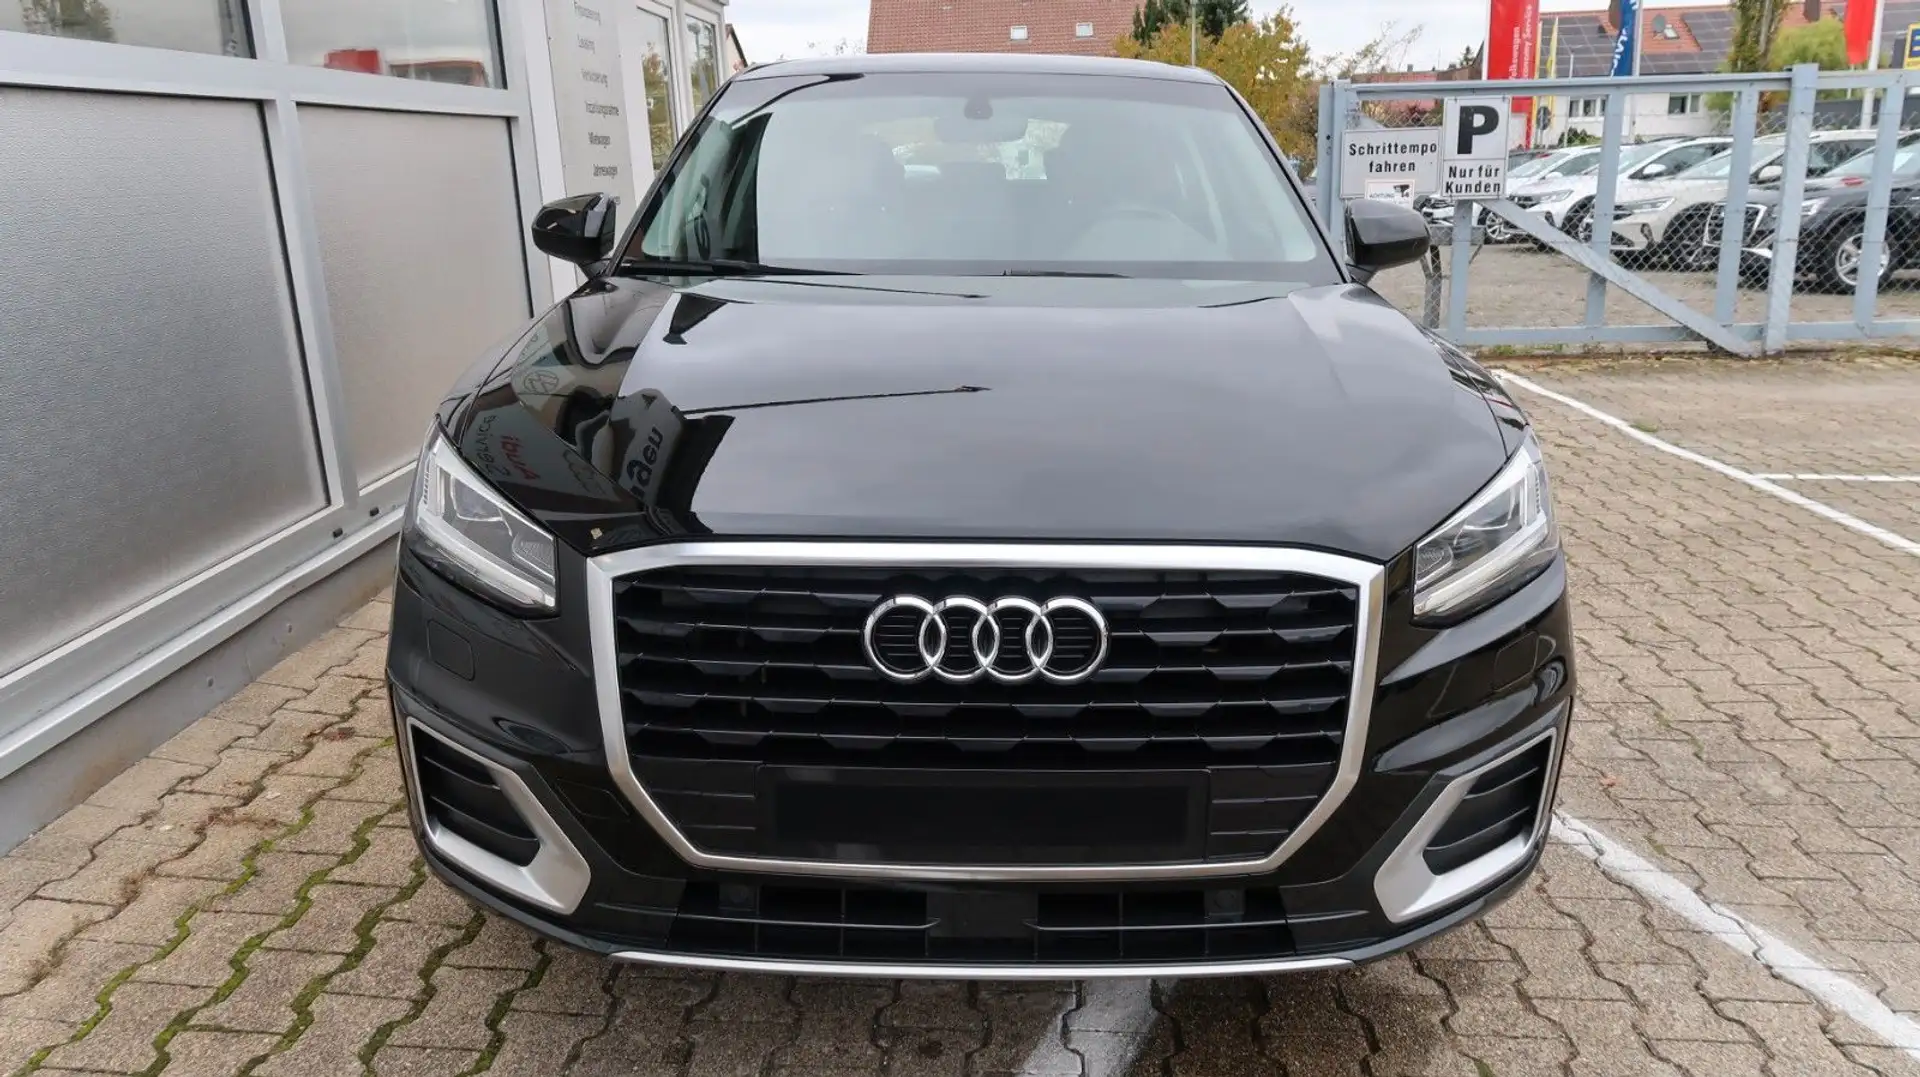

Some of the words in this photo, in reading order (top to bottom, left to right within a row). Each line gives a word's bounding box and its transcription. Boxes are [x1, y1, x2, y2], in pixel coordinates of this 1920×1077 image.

[1523, 41, 1533, 79] conomy
[1457, 105, 1499, 155] P
[1348, 141, 1437, 156] Schrittempo
[1369, 160, 1415, 173] fahren
[1449, 166, 1472, 178] Nur
[1478, 165, 1500, 178] für
[1445, 180, 1501, 194] Kunden
